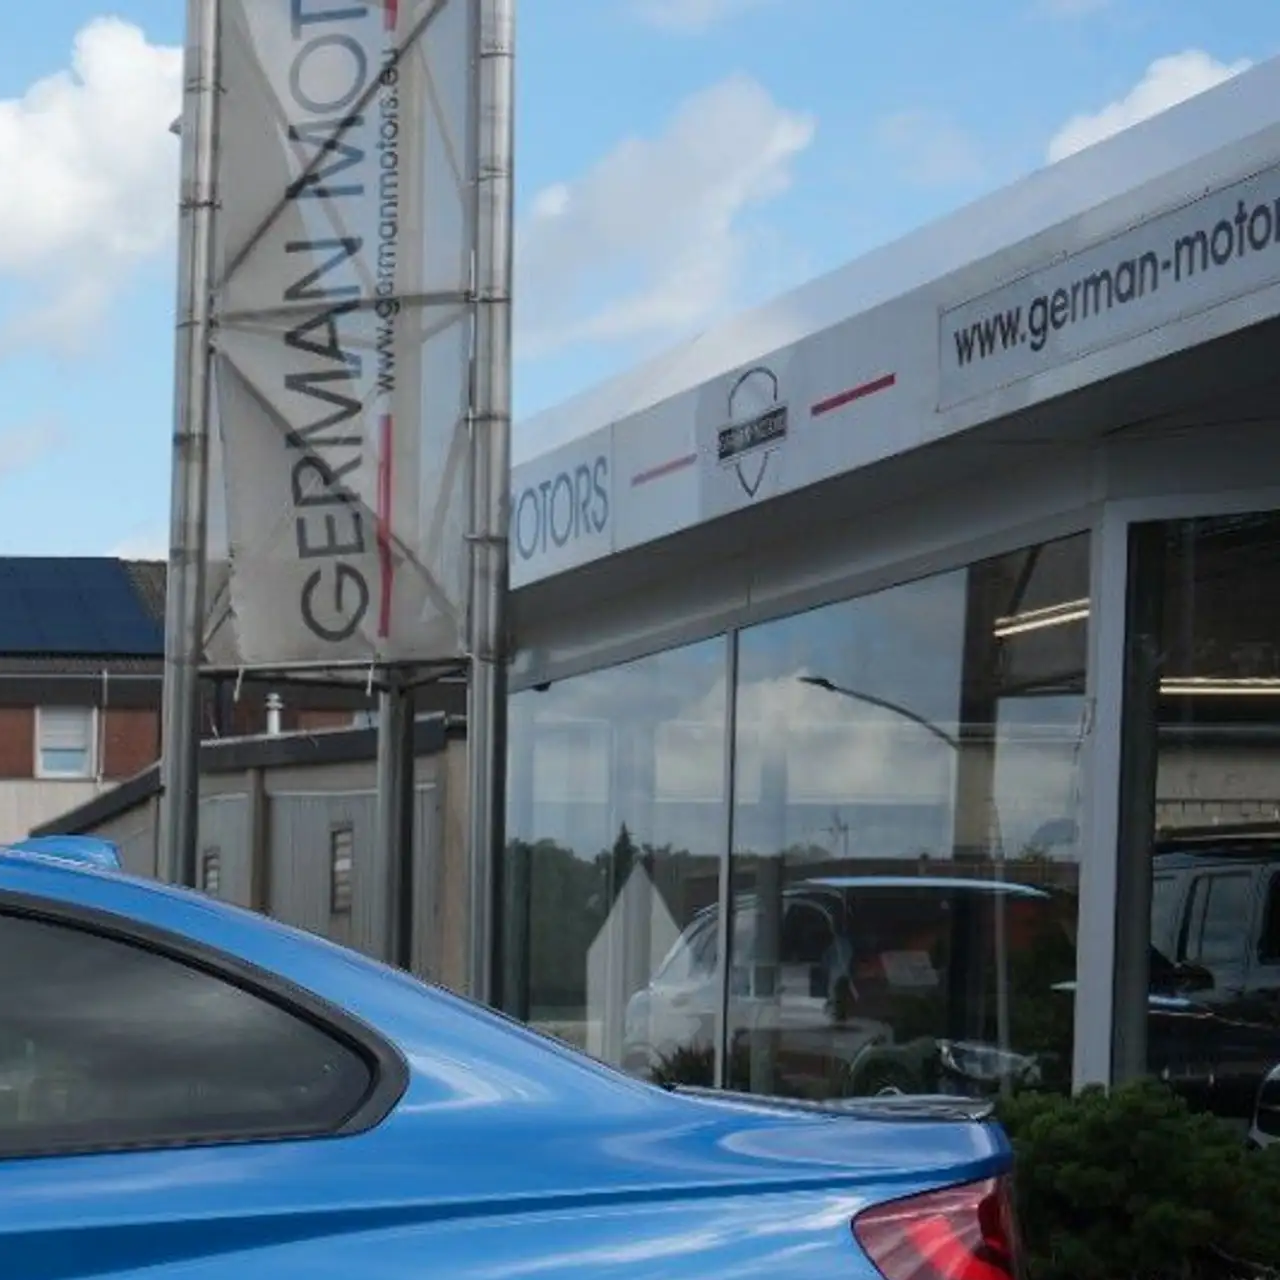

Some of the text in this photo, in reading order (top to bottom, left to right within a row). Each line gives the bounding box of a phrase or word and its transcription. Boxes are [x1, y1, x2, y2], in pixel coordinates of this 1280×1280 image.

[375, 48, 401, 397] www.germanmotors.eu
[284, 236, 370, 642] GERMAN
[511, 454, 610, 563] OTORS
